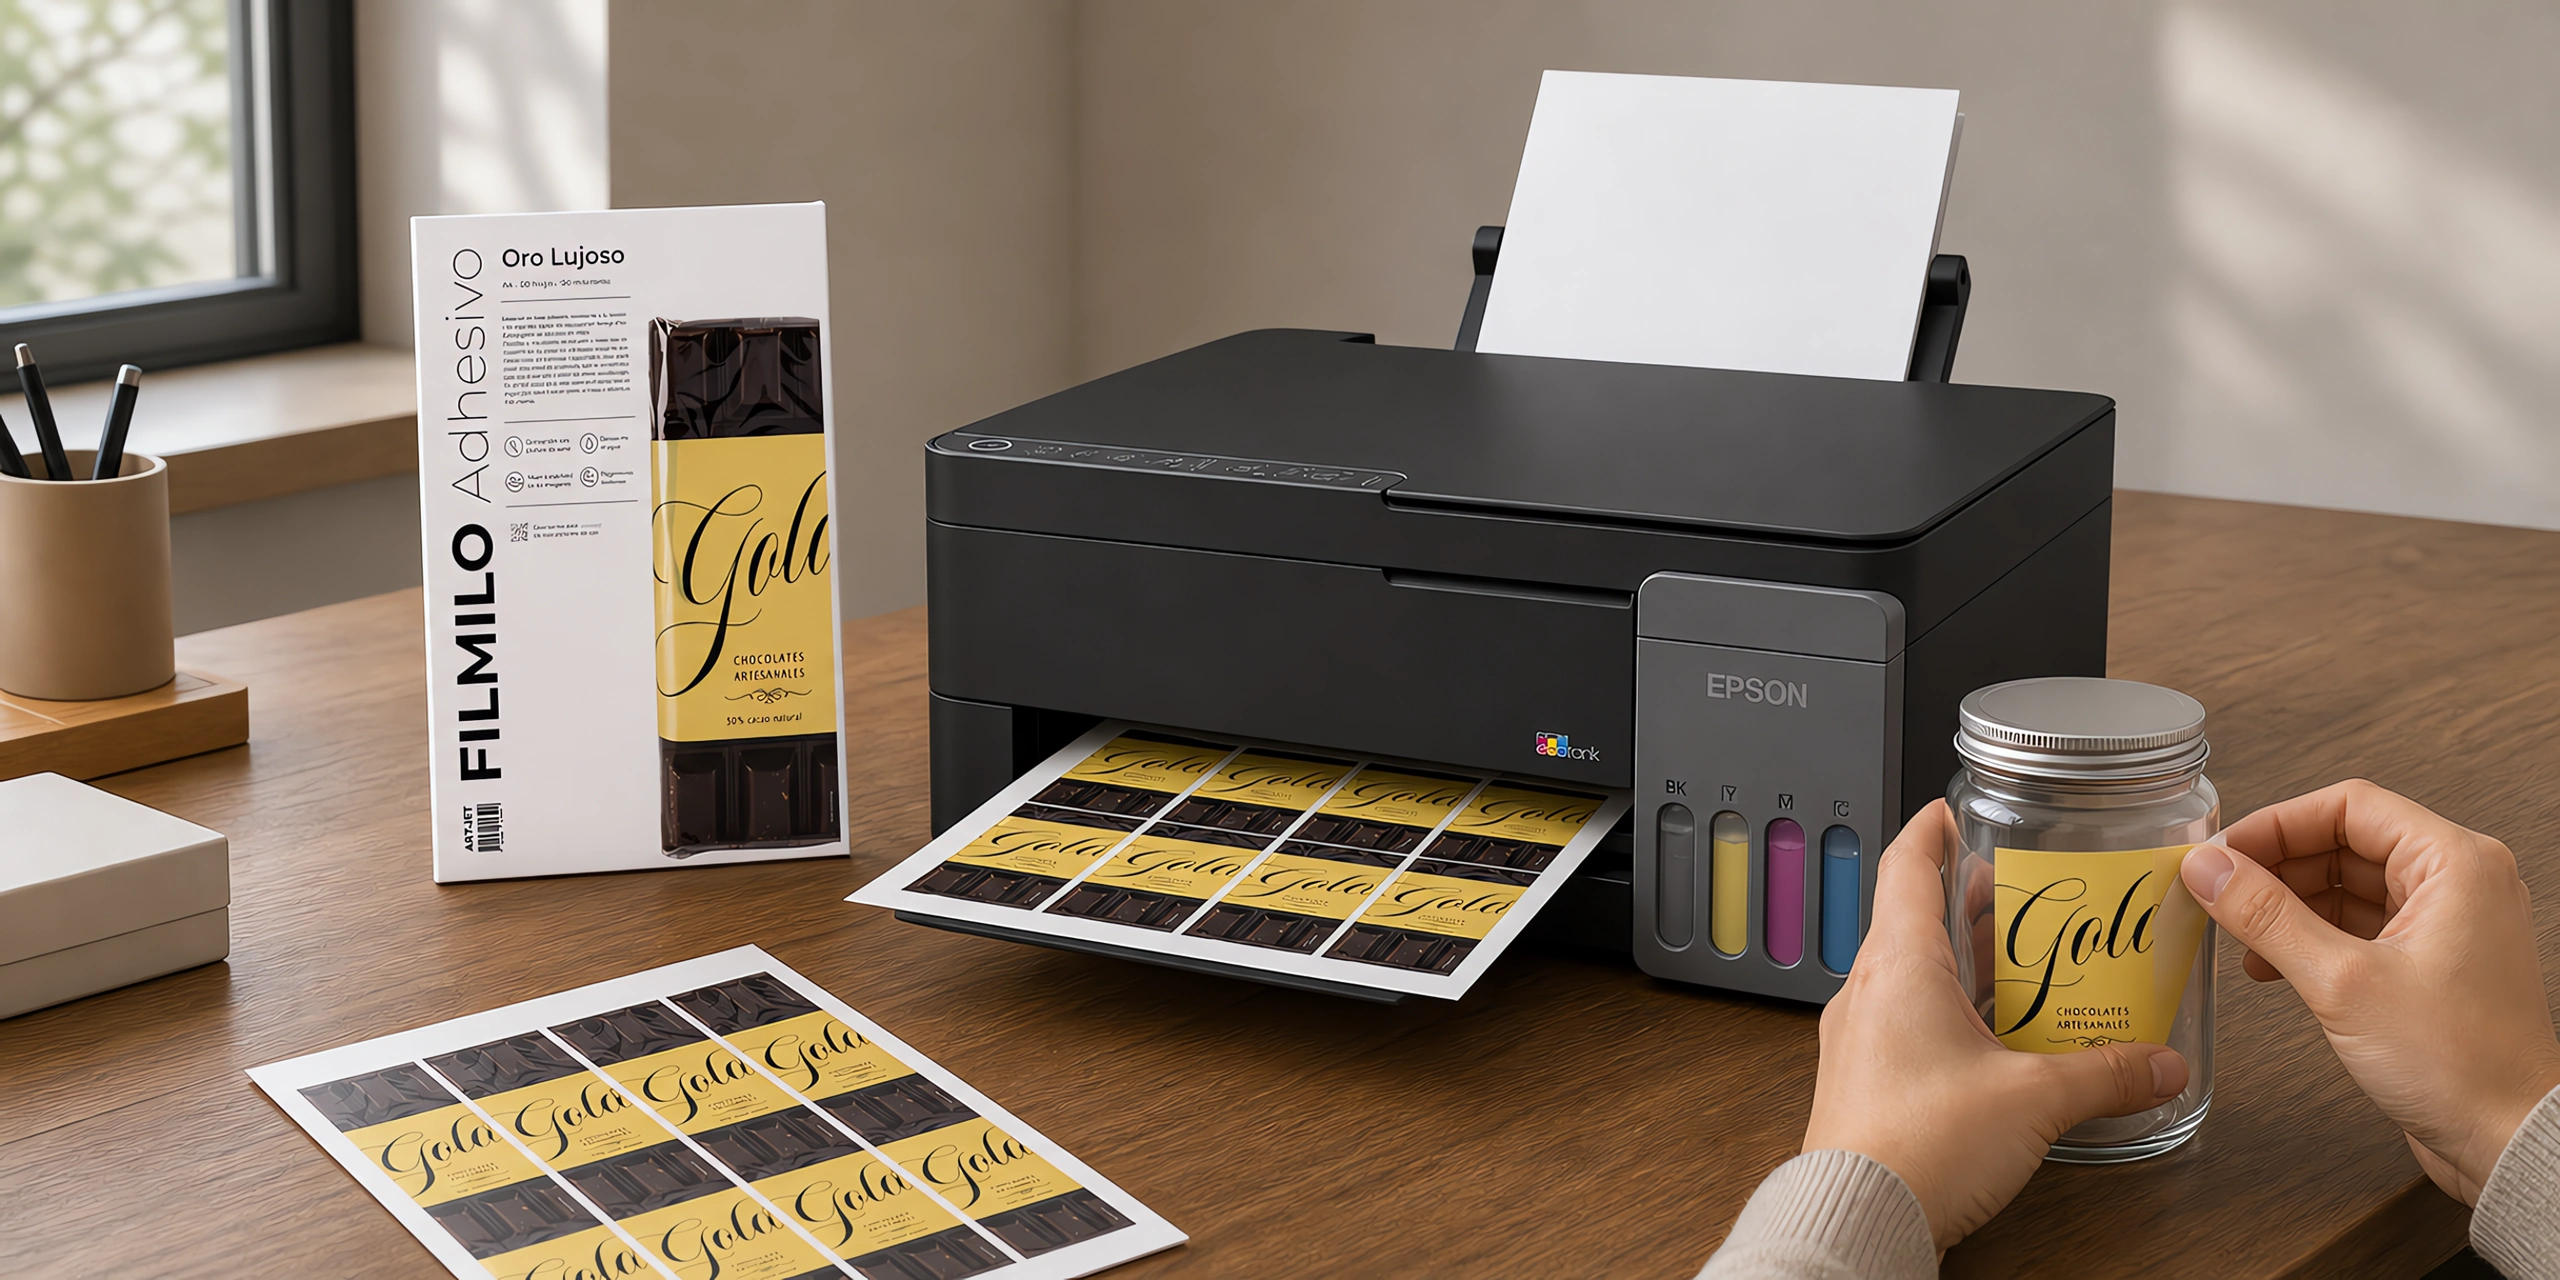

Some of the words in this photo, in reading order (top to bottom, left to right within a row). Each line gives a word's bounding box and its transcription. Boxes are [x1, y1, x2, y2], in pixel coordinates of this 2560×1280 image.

[502, 248, 544, 267] Oro
[551, 245, 625, 270] Lujoso
[445, 248, 492, 504] Adhesivo
[451, 523, 502, 781] FILMILO
[733, 652, 804, 666] CHOCOLATES
[1706, 672, 1808, 709] EPSON
[1666, 779, 1687, 796] BK
[2056, 1006, 2129, 1017] CHOCOLATES
